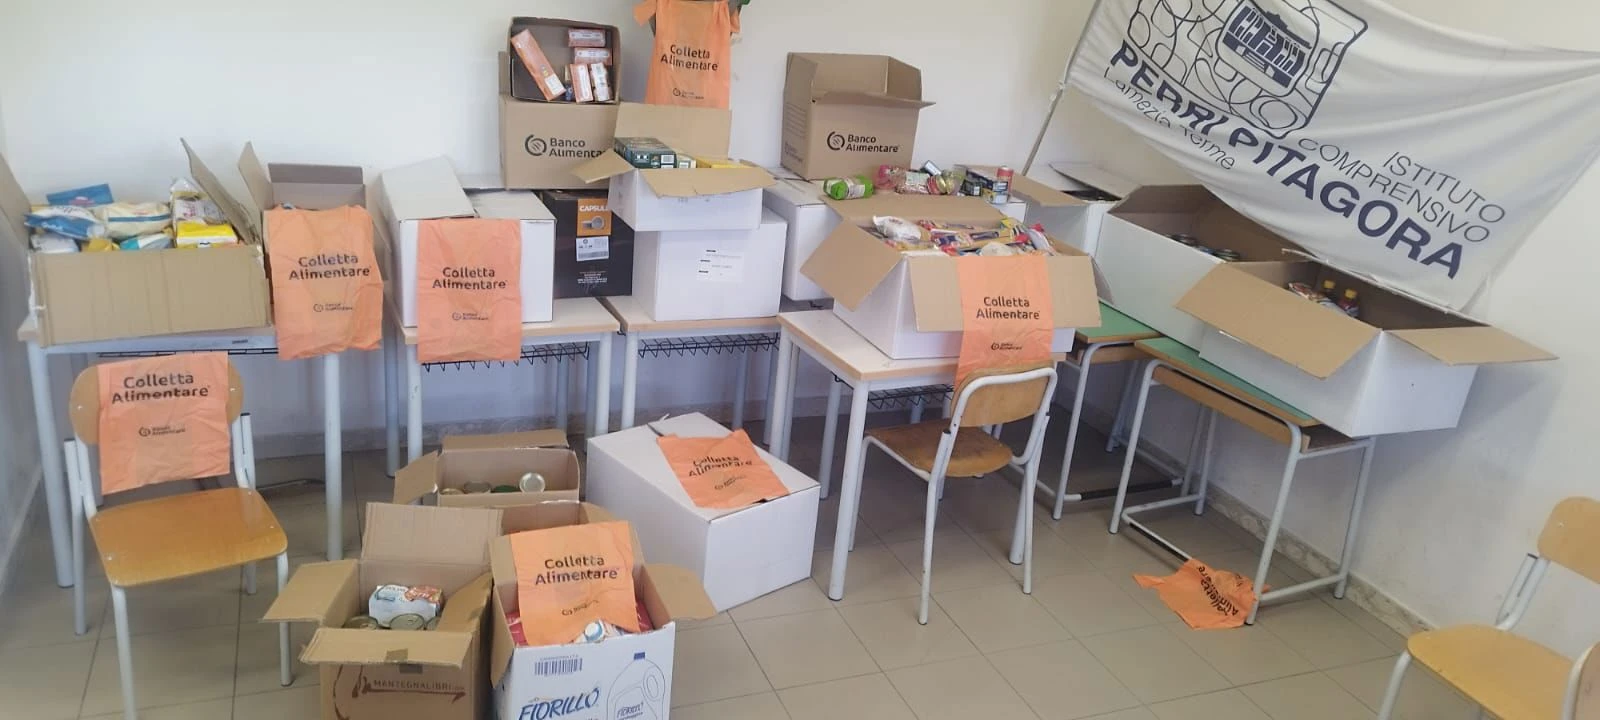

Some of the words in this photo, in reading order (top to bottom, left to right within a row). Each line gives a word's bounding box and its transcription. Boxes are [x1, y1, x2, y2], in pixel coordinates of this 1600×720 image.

[669, 44, 711, 59] Colletta
[660, 55, 719, 72] Alimentare
[549, 137, 586, 149] Banco
[847, 133, 877, 144] Banco
[549, 147, 603, 158] Alimenta
[845, 142, 899, 154] Alimentare
[1110, 40, 1229, 136] PERRI
[1228, 127, 1463, 280] PITAGORA
[1298, 138, 1490, 243] COMPRENSIVO
[1382, 151, 1506, 223] ISTITUTO
[298, 253, 359, 268] Colletta
[288, 266, 371, 280] Alimentare
[442, 266, 496, 279] Colletta
[432, 279, 507, 290] Alimentare
[983, 295, 1030, 308] Colletta
[975, 308, 1040, 320] Alimentare
[123, 373, 194, 389] Colletta
[111, 385, 209, 404] Alimentare
[544, 555, 605, 570] Colletta
[535, 567, 618, 586] Alimentare
[517, 687, 600, 720] FIORILLO
